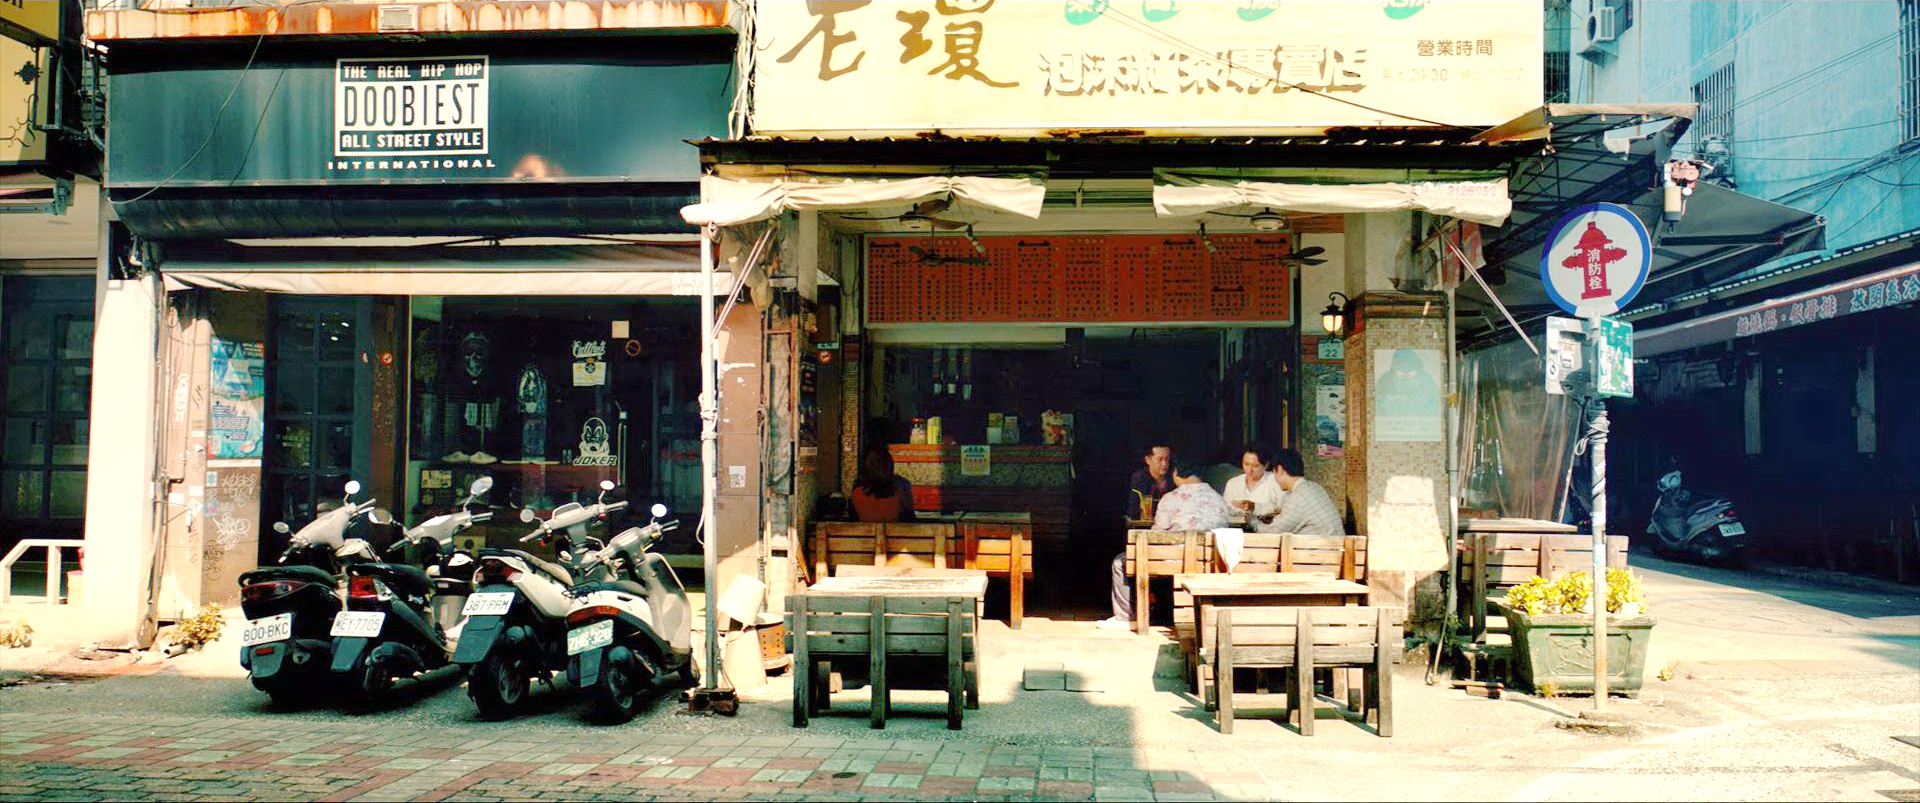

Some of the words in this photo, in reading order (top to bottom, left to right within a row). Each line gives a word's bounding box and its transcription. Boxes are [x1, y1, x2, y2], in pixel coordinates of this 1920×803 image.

[1417, 39, 1493, 57] 營業時間
[343, 65, 368, 79] THE
[377, 64, 411, 78] REAL
[421, 64, 446, 78] HIP
[455, 62, 482, 77] HOP
[344, 83, 480, 127] DOOBIEST
[342, 134, 370, 148] ALL
[377, 133, 431, 148] STREET
[435, 132, 481, 147] STYLE
[327, 159, 496, 170] INTERNATIONAL
[1587, 248, 1603, 290] 消防栓
[1325, 349, 1338, 358] 22
[572, 454, 618, 466] JOKER
[243, 622, 288, 642] 800-BKC
